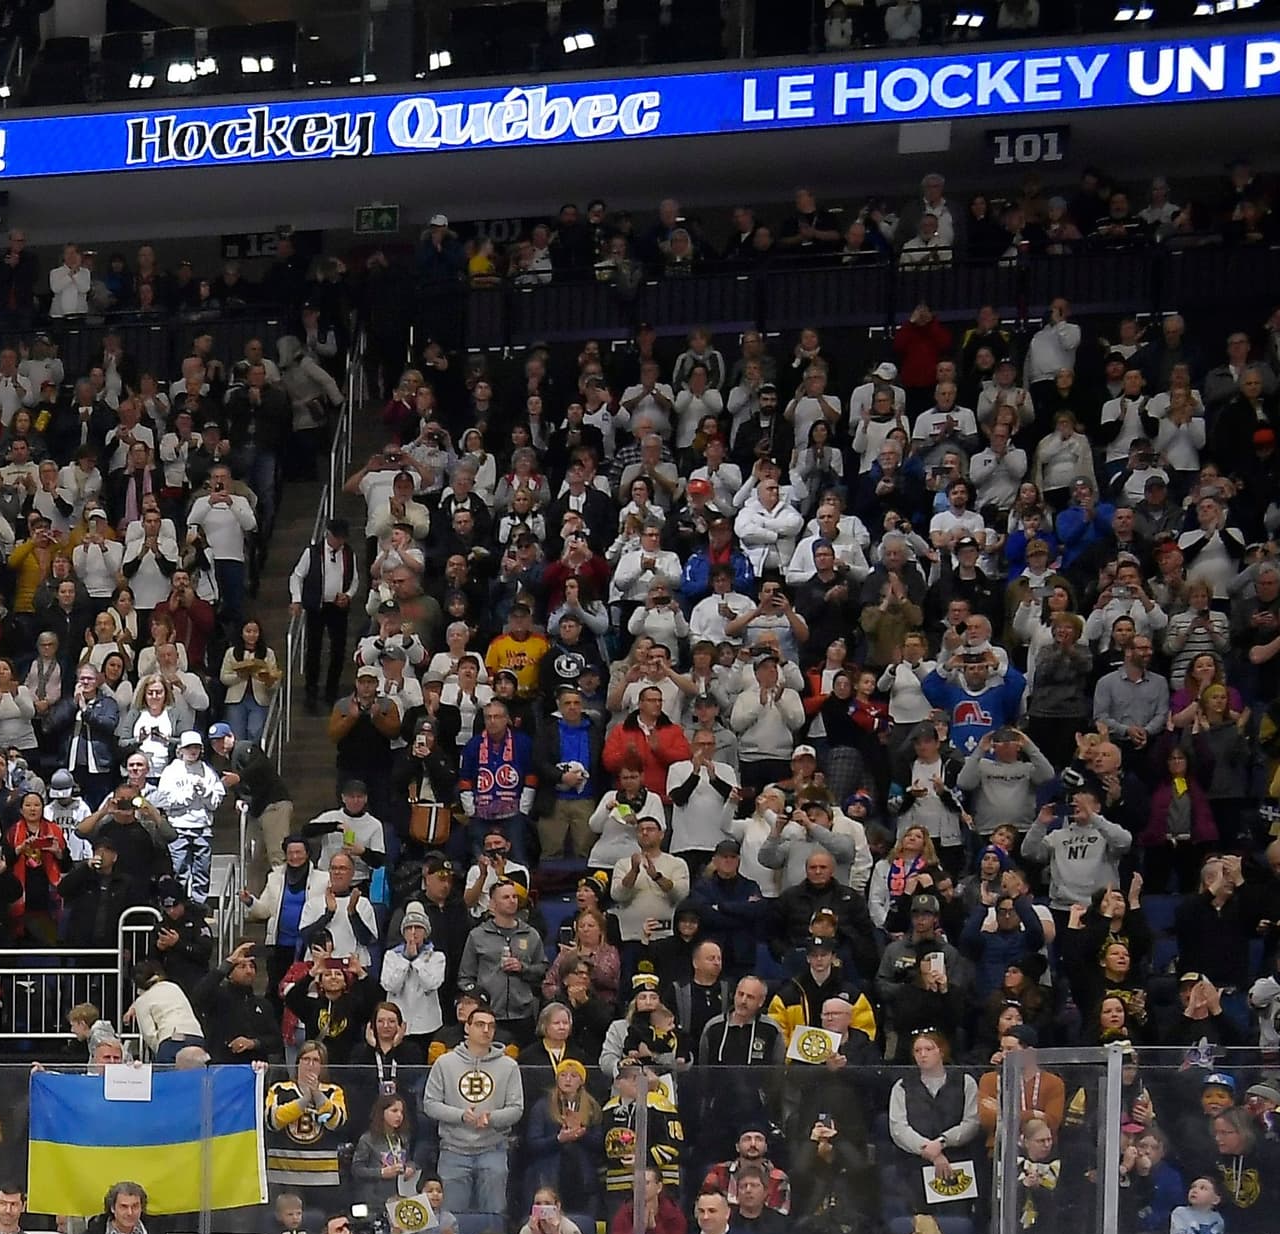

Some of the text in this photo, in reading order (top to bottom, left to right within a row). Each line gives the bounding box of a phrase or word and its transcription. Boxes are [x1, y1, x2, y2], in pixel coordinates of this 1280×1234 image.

[743, 75, 815, 121] LE
[834, 54, 1110, 116] HOCKEY
[1128, 45, 1226, 97] UN
[126, 86, 660, 164] Hockey Québec
[994, 132, 1062, 164] 101
[247, 234, 278, 256] 12
